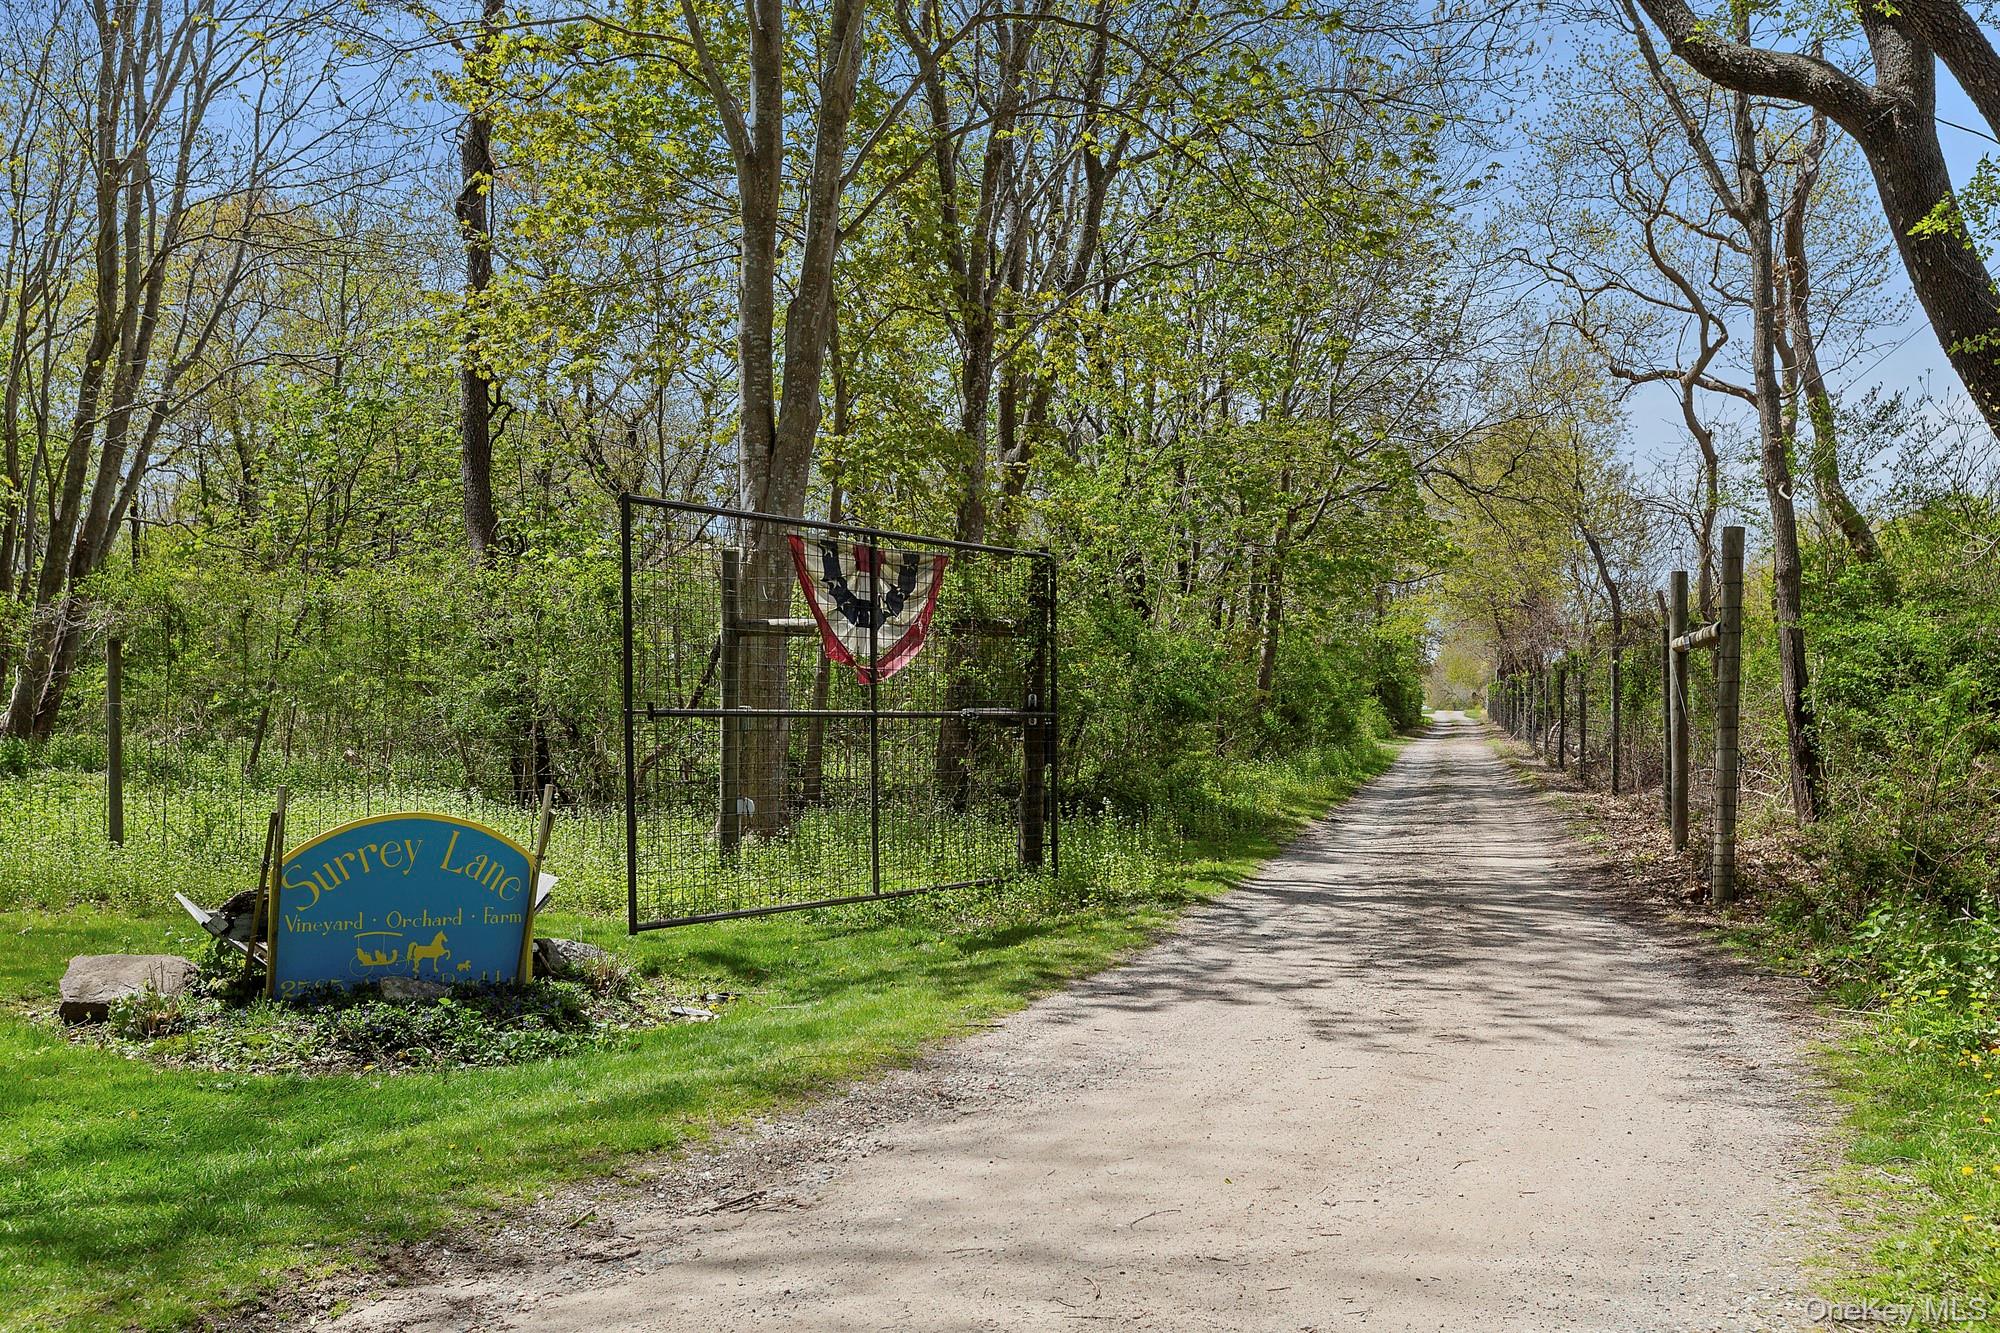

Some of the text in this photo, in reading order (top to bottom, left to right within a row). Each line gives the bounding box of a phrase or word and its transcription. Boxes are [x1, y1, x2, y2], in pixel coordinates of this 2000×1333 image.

[282, 830, 521, 911] Surrey Lane
[285, 907, 522, 935] Vineyard Orchard Farm
